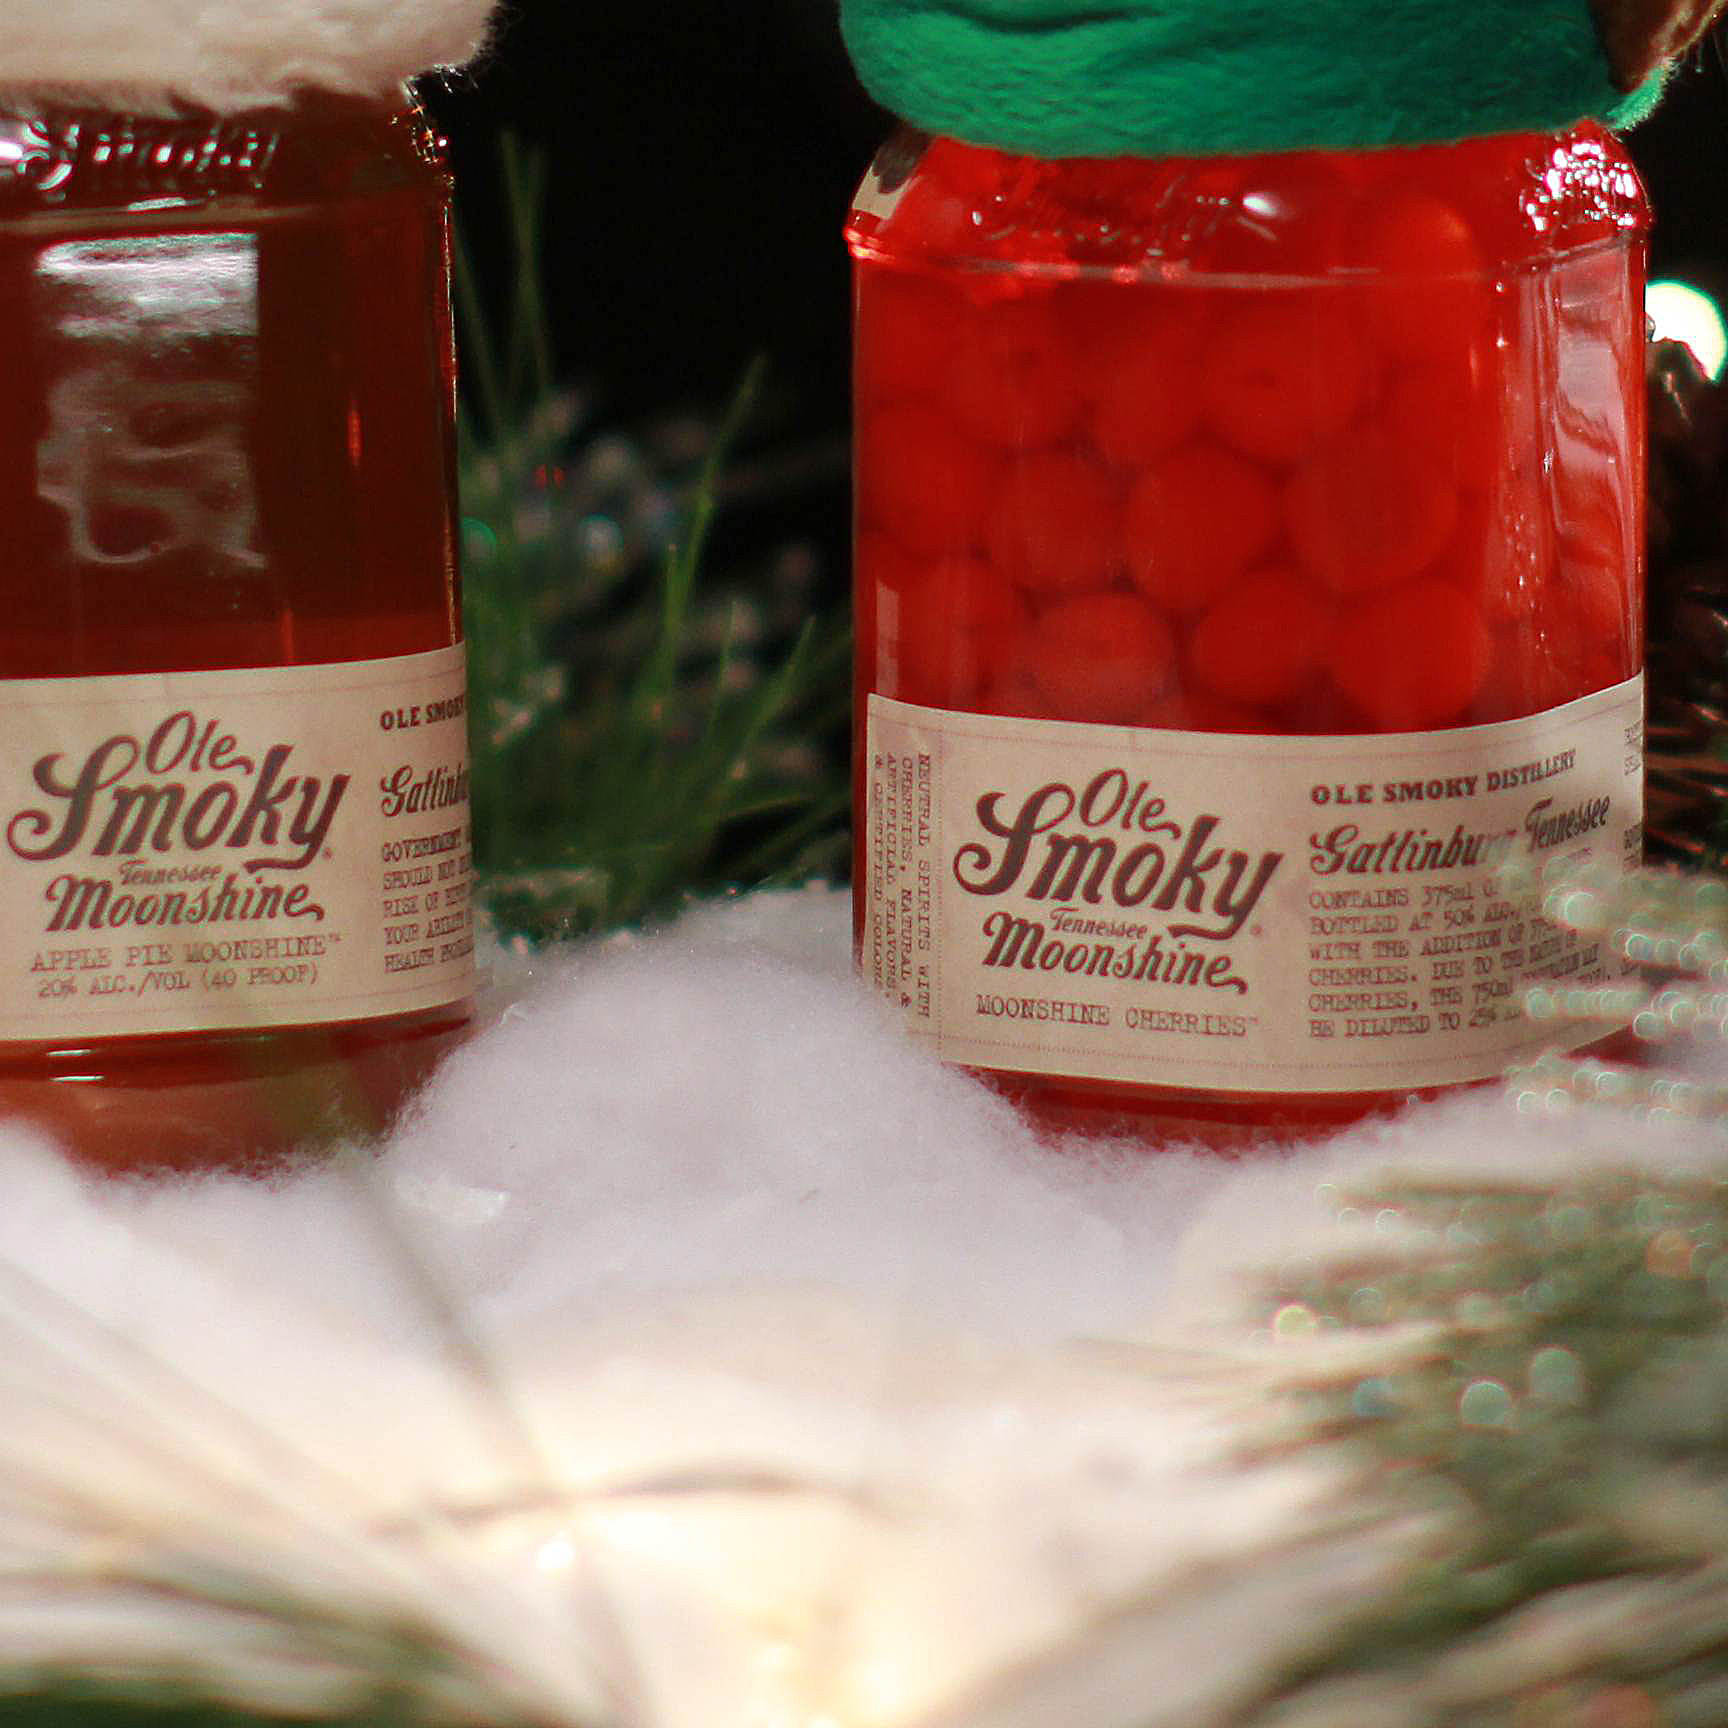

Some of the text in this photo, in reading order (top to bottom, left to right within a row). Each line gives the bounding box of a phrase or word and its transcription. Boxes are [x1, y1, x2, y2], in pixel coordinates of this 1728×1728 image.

[379, 705, 421, 731] OLE
[146, 710, 255, 775] Ole
[1310, 748, 1577, 805] OLE SMOKY DISTILLERY
[6, 734, 352, 873] Smoky
[1079, 767, 1181, 841] Ole
[1525, 795, 1611, 853] Tennessee
[118, 859, 224, 886] Tennessee
[953, 782, 1285, 941] Smoky
[44, 872, 325, 932] Moonshine
[917, 753, 931, 1018] NEUTRAL SPIRITS WITH
[1309, 888, 1410, 910] CONTAINS
[900, 888, 912, 981] NATURAL
[1049, 907, 1148, 940] Tennessee
[1309, 915, 1399, 937] BOTTLED
[1408, 912, 1432, 933] AT
[30, 947, 113, 973] APPLE
[125, 943, 174, 968] PIE
[982, 911, 1248, 995] Moonshine
[1309, 940, 1362, 962] WITH
[1372, 939, 1410, 960] THE
[1420, 928, 1502, 957] ADDITION
[38, 976, 78, 1000] 20%
[89, 971, 191, 998] ALC./VOL
[1430, 987, 1464, 1007] THE
[975, 994, 1111, 1026] MOONSHINE
[1345, 1015, 1430, 1038] DILUTED
[1439, 1011, 1461, 1032] TO
